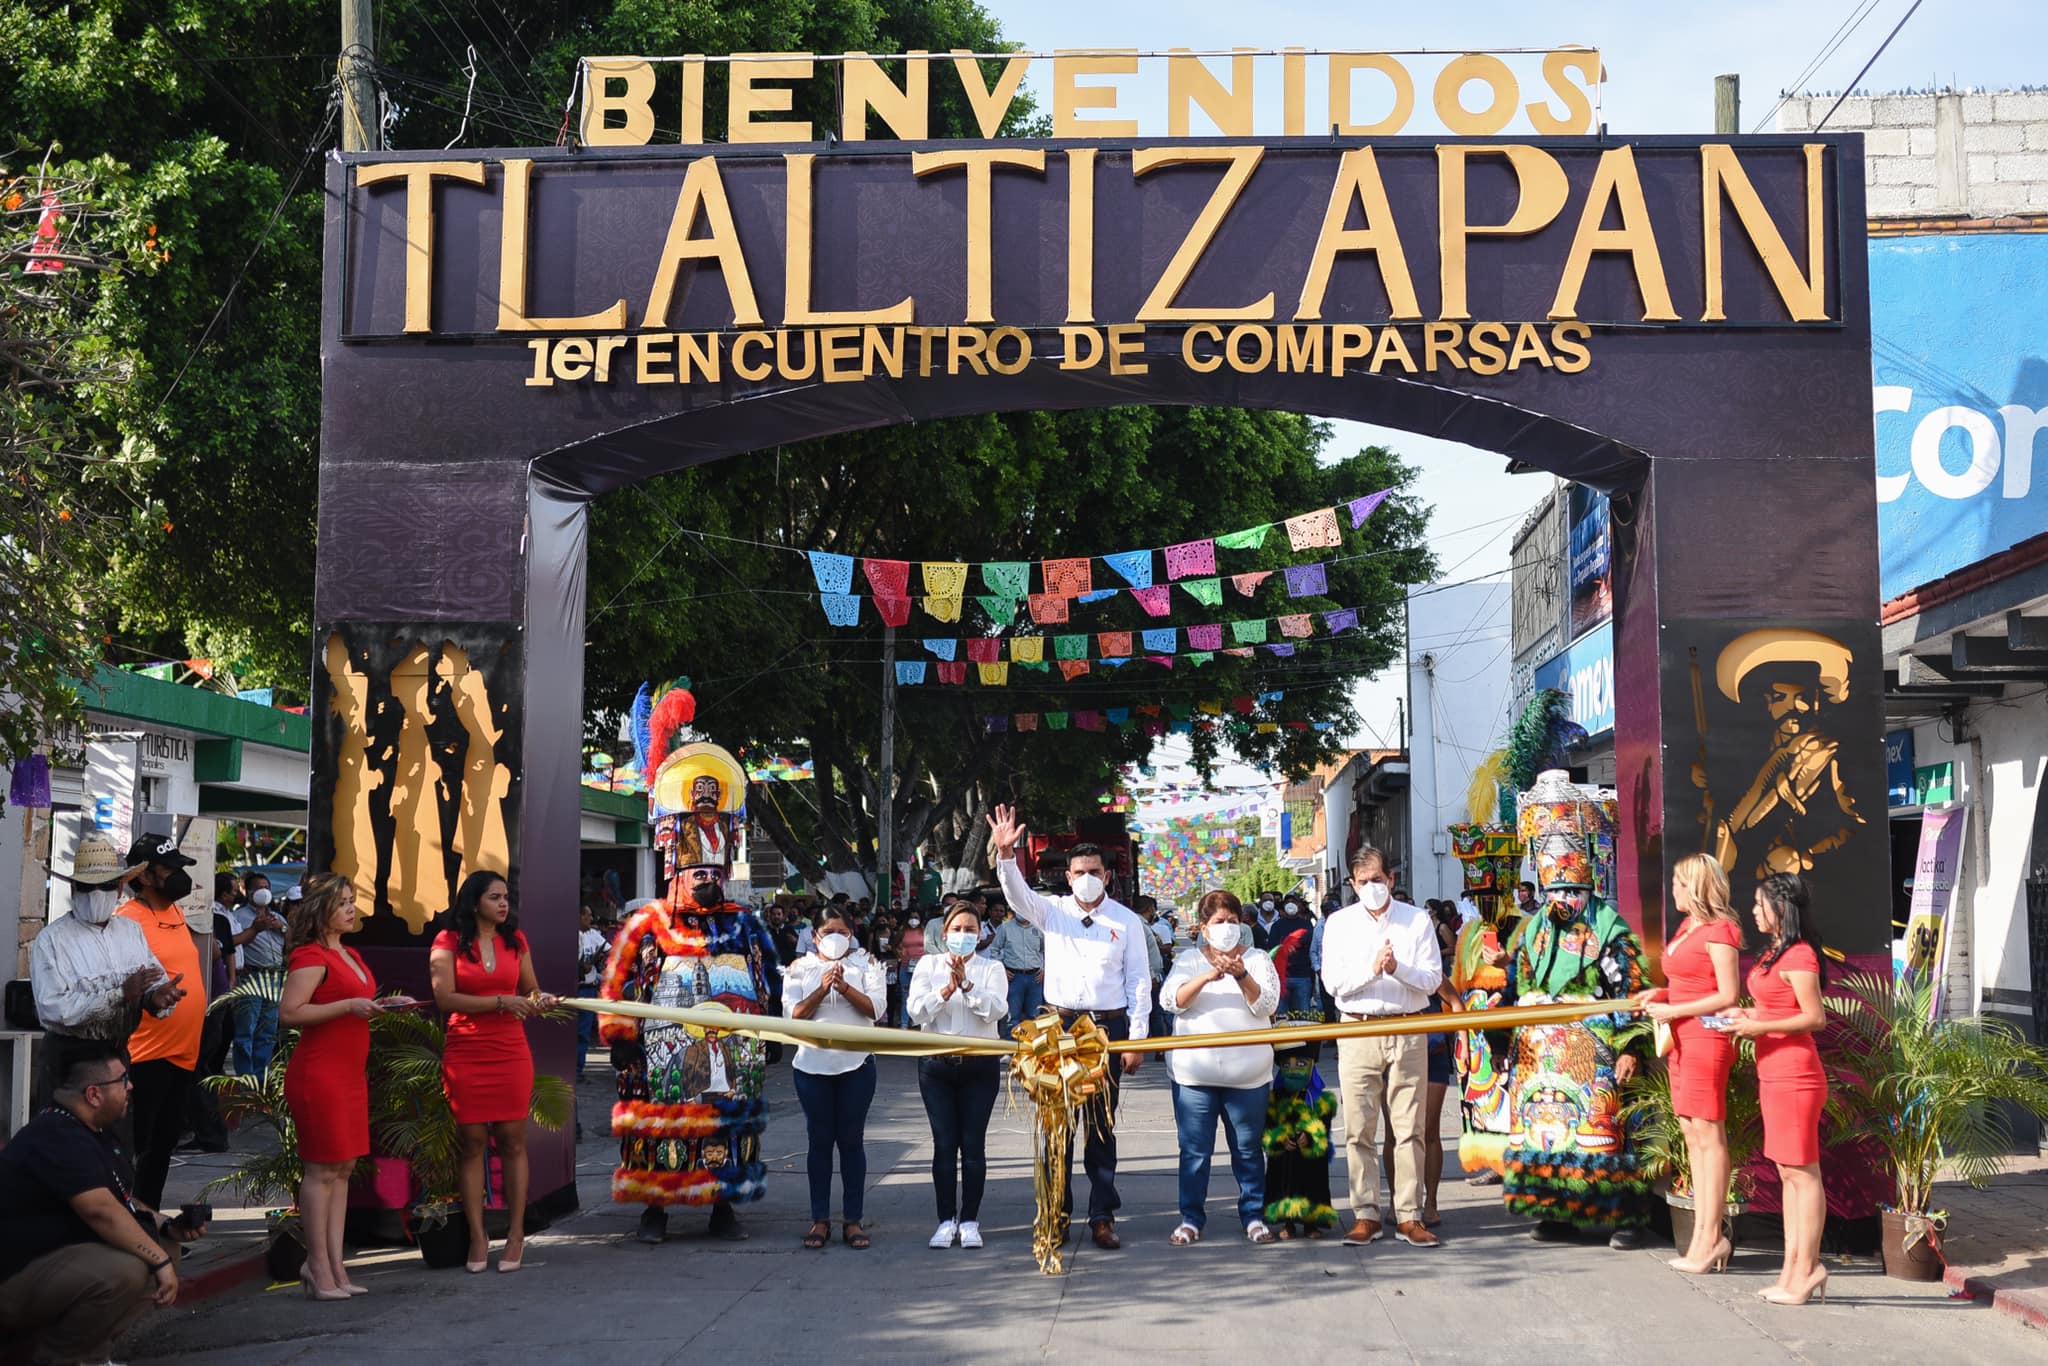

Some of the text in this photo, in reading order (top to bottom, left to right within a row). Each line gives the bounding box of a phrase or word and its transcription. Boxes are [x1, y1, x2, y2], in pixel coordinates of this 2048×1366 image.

[587, 45, 1606, 148] BIENVENIDOS
[356, 143, 1830, 334] TLALTIZAPAN
[525, 320, 1593, 387] 1er ENCUENTRO DE COMPARSAS
